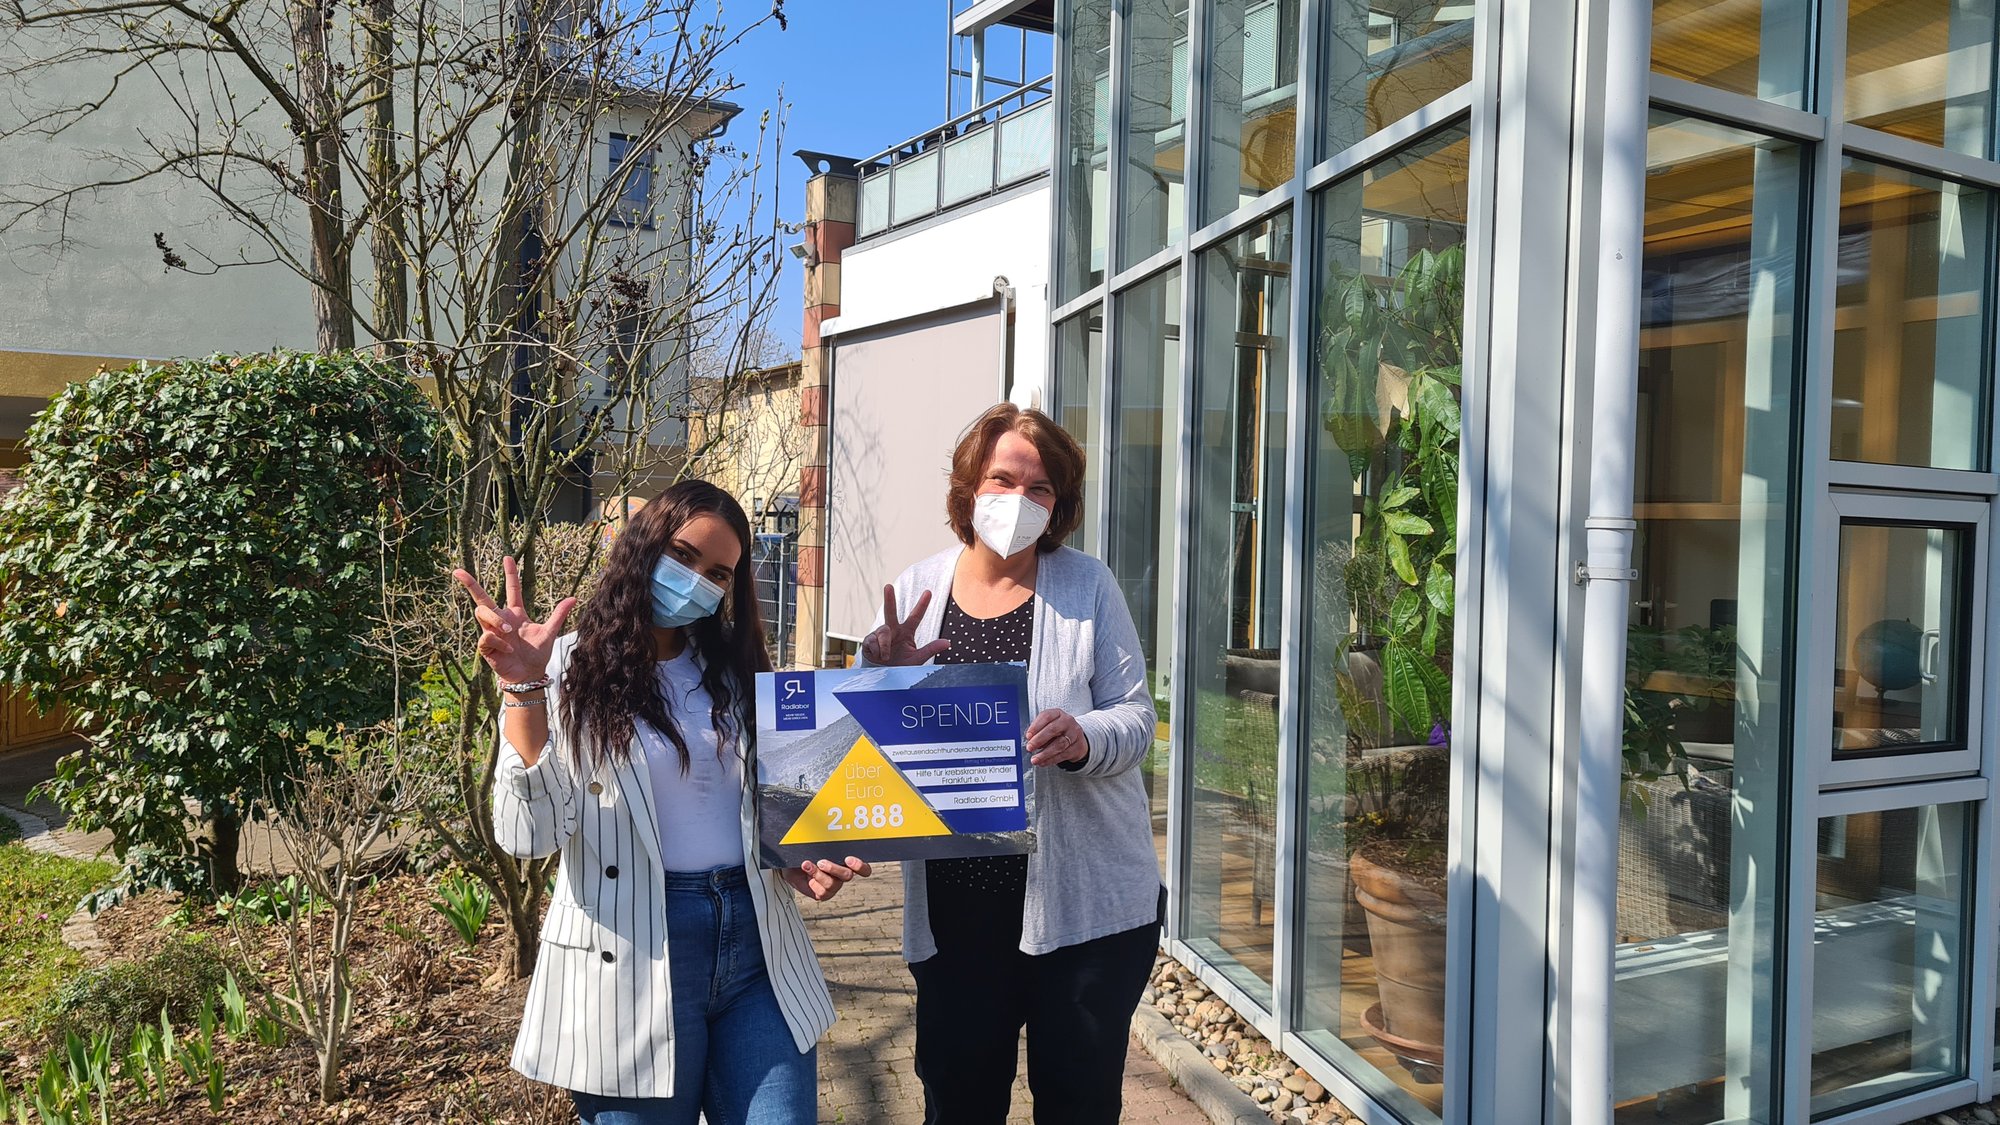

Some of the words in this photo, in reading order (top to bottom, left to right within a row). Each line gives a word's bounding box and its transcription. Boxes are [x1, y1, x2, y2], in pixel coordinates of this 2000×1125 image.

[901, 701, 1010, 729] SPENDE
[845, 762, 883, 780] über
[916, 769, 932, 778] Hilfe
[934, 768, 943, 777] für
[945, 766, 988, 777] krebskranke
[989, 765, 1012, 774] Kinder
[942, 776, 973, 785] Frankfurt
[845, 782, 884, 800] Euro
[953, 795, 988, 805] Radlabor
[989, 794, 1014, 803] GmbH
[827, 803, 904, 831] 2.888
